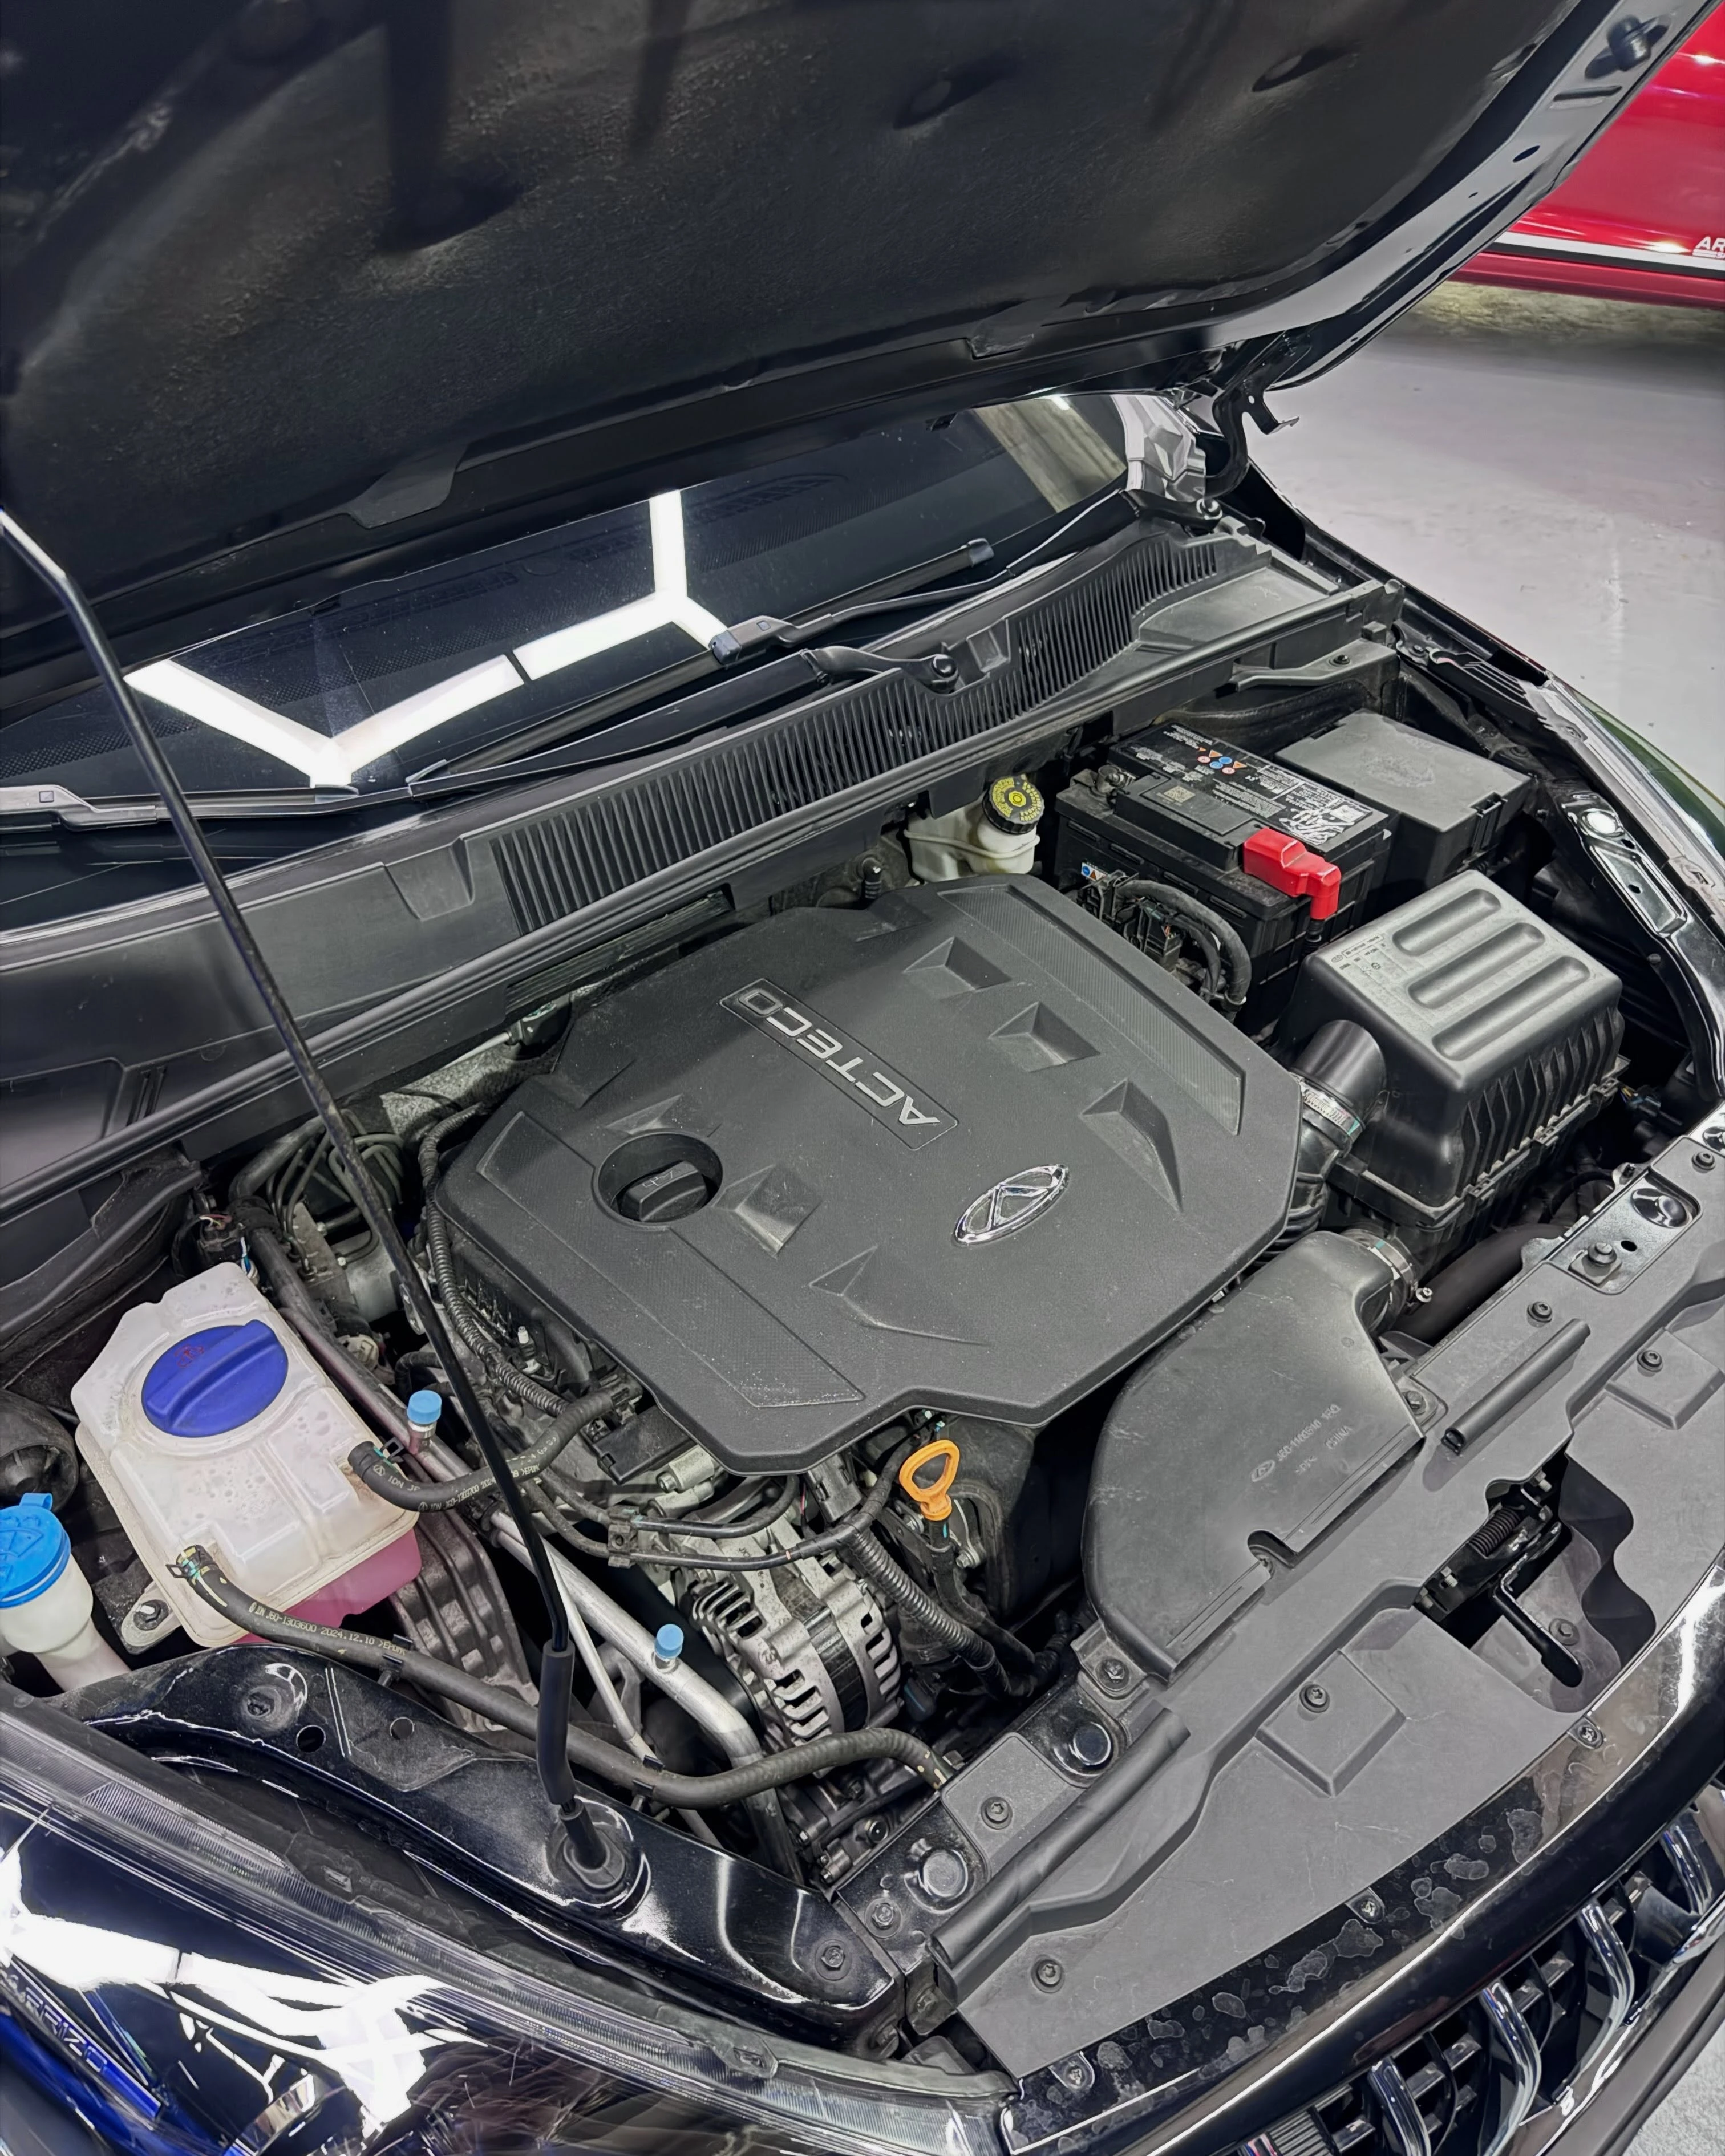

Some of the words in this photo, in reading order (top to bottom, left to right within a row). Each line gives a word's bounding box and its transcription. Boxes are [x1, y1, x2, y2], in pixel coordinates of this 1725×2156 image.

[738, 988, 941, 1126] ACTECO
[266, 1610, 317, 1632] J60-1303600
[320, 1627, 375, 1645] 2024.12.10
